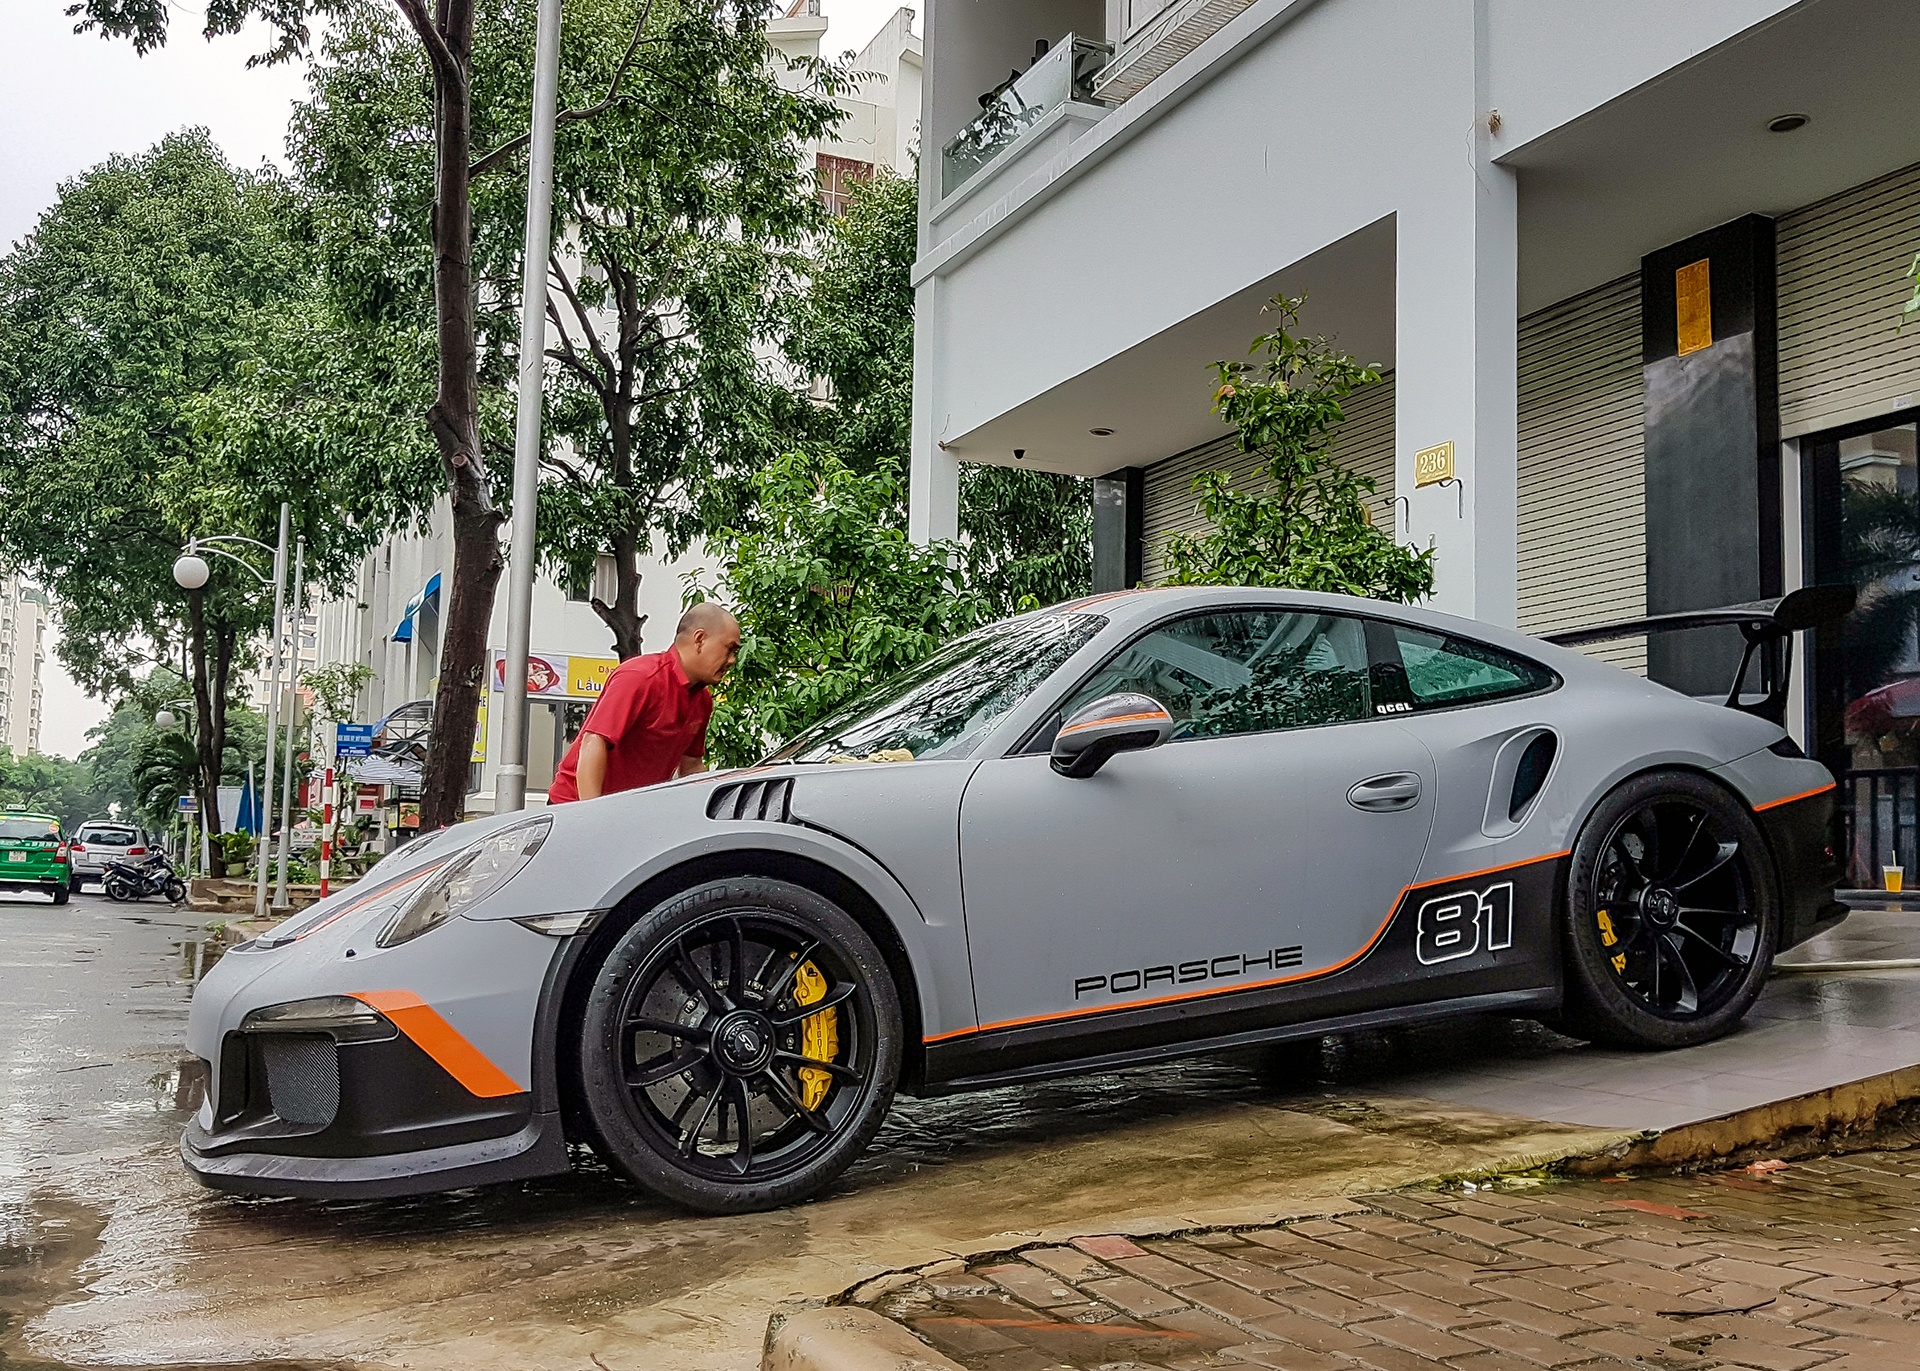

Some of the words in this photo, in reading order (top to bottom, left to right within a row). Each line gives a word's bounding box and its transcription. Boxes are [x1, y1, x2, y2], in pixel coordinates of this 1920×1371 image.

[1420, 449, 1446, 473] 236
[1376, 702, 1414, 714] QCGL
[1415, 880, 1515, 966] 81
[1074, 944, 1304, 1001] PORSCHE
